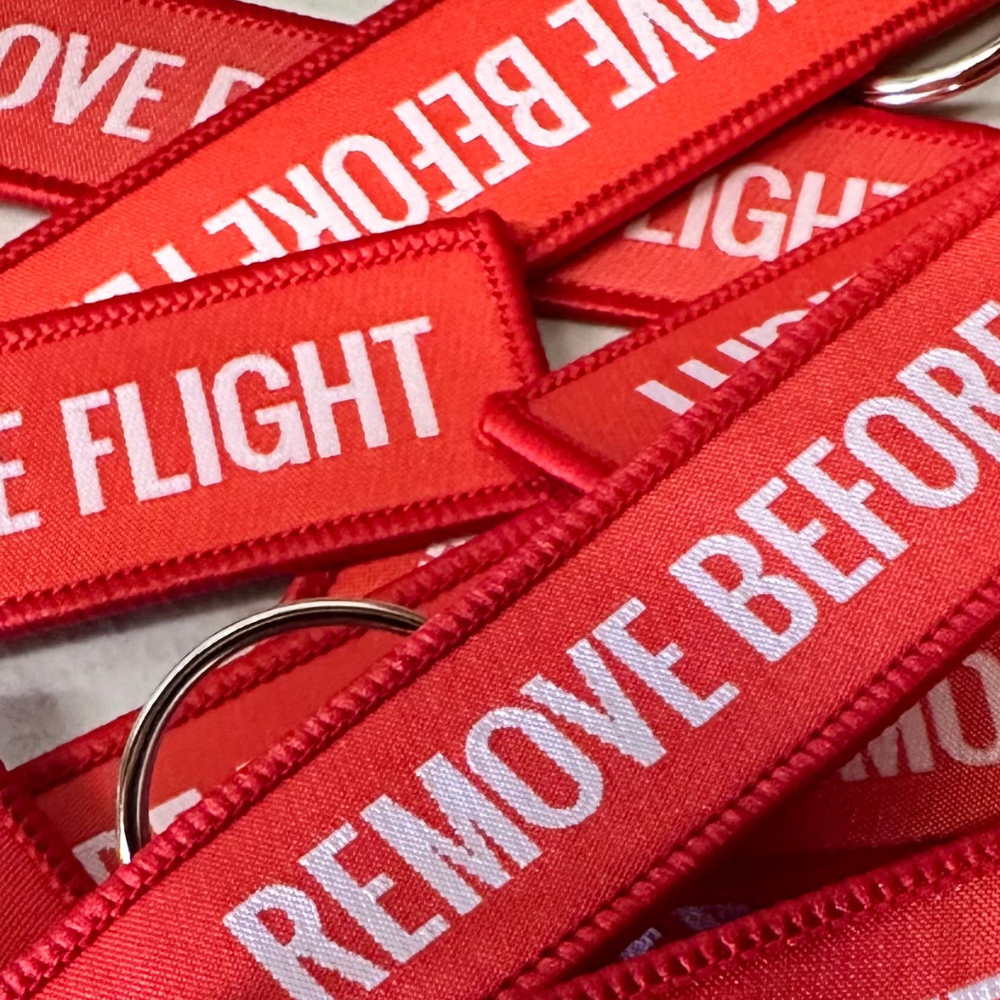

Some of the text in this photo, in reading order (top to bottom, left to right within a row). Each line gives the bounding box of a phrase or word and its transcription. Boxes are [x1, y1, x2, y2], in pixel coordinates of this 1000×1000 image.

[0, 23, 186, 142] OVE
[546, 0, 797, 110] VE
[623, 164, 908, 262] IGH
[59, 316, 440, 516] FLIGHT
